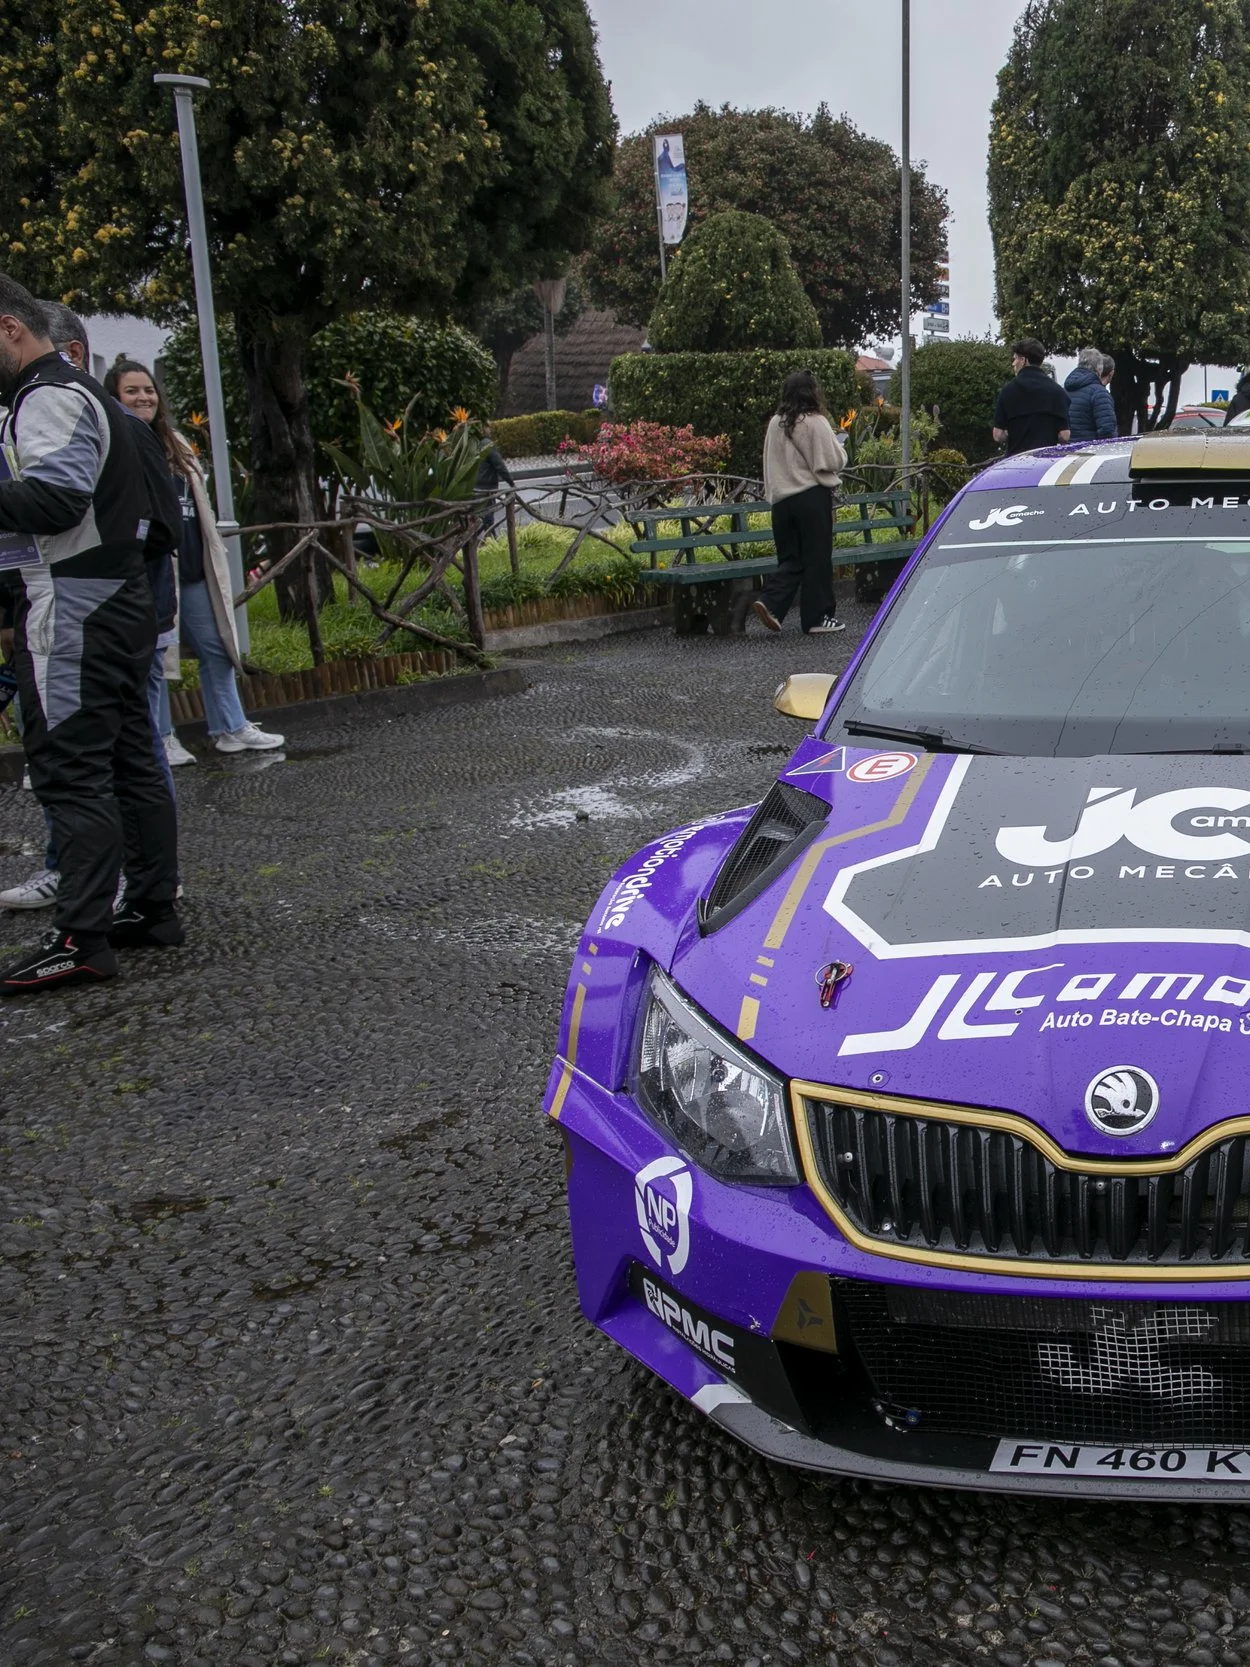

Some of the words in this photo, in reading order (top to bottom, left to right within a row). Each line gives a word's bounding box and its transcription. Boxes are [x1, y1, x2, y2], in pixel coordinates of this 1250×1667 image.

[1068, 499, 1170, 516] AUTO
[977, 865, 1096, 889] AUTO
[36, 960, 76, 978] sparco
[1039, 1011, 1093, 1032] Auto
[1099, 1008, 1232, 1032] Bate-Chapa
[647, 1186, 677, 1233] NP
[1009, 1444, 1081, 1469] FN
[1096, 1449, 1188, 1473] 460
